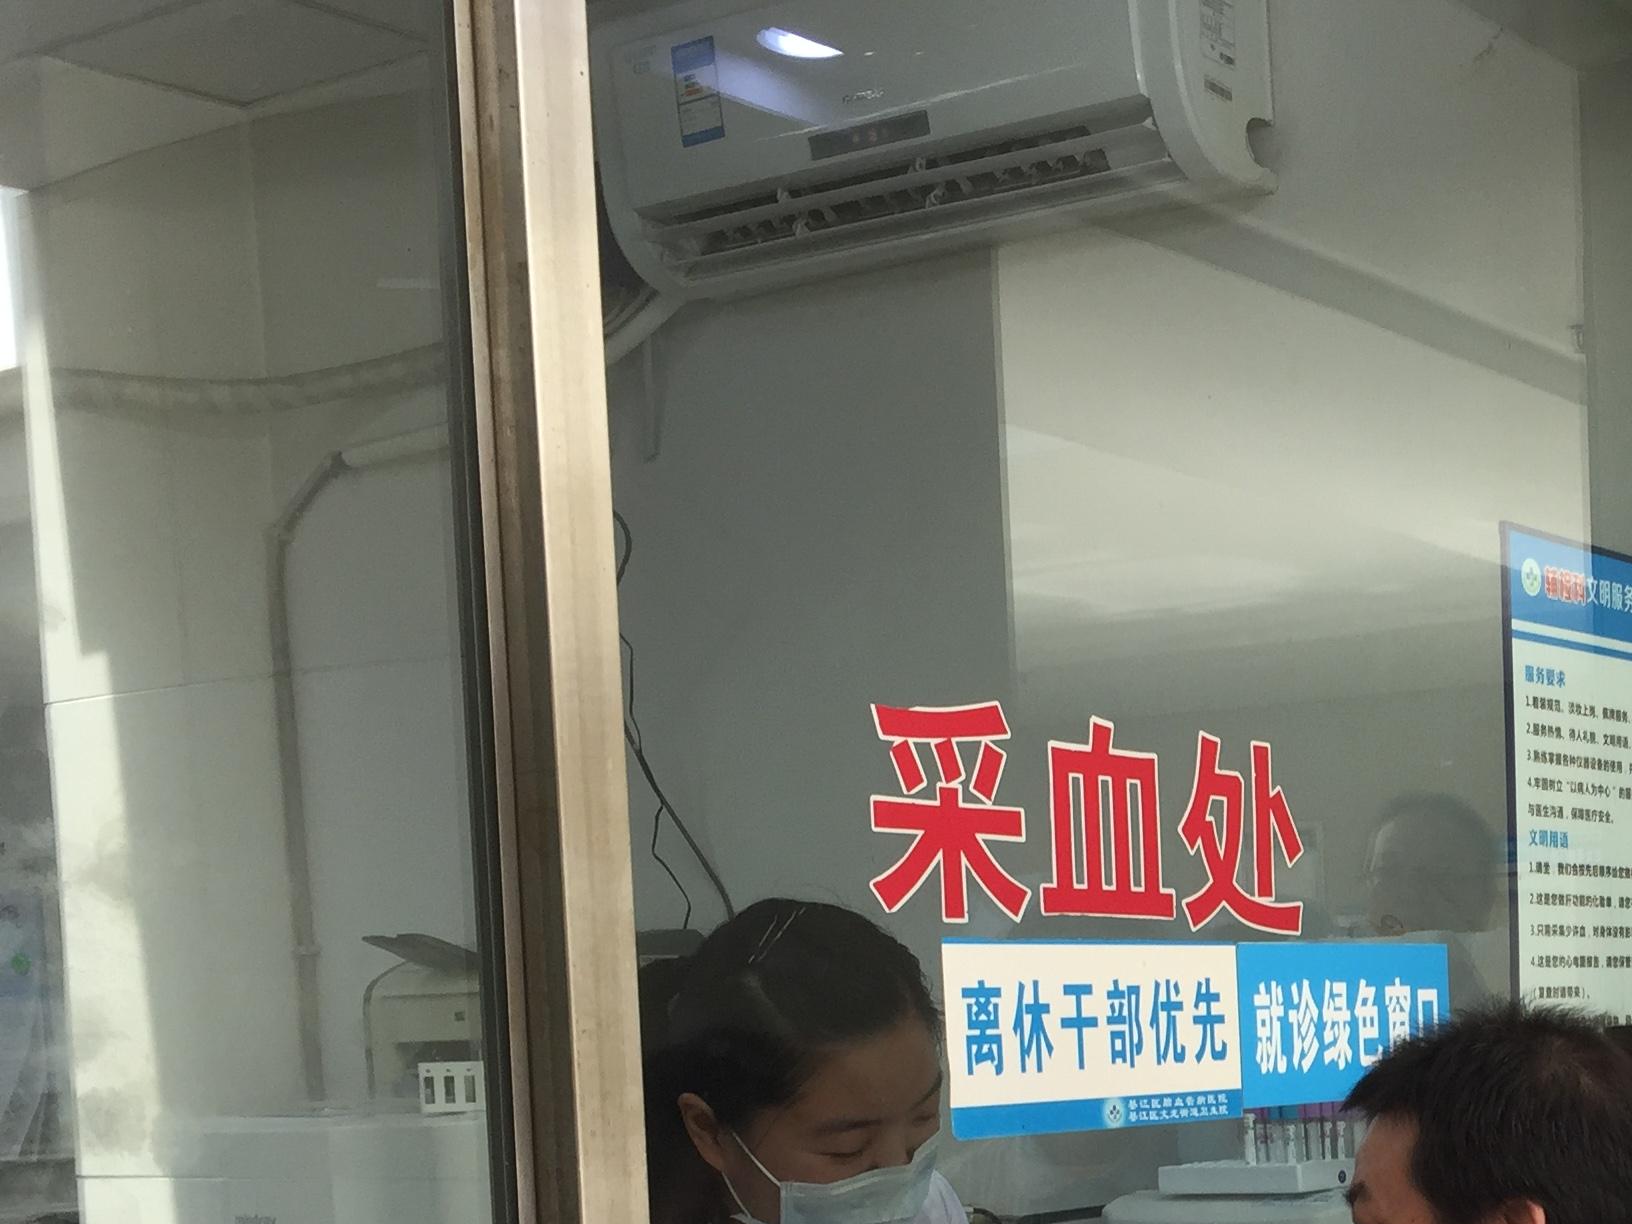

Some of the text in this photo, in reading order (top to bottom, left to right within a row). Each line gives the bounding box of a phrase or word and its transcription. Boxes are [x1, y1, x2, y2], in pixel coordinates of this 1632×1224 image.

[1524, 664, 1566, 688] 服务要求
[869, 700, 1305, 936] 采血处
[1529, 829, 1569, 849] 文明用语
[961, 979, 1228, 1077] 离休干部优先
[1254, 977, 1439, 1074] 就诊绿色窗口
